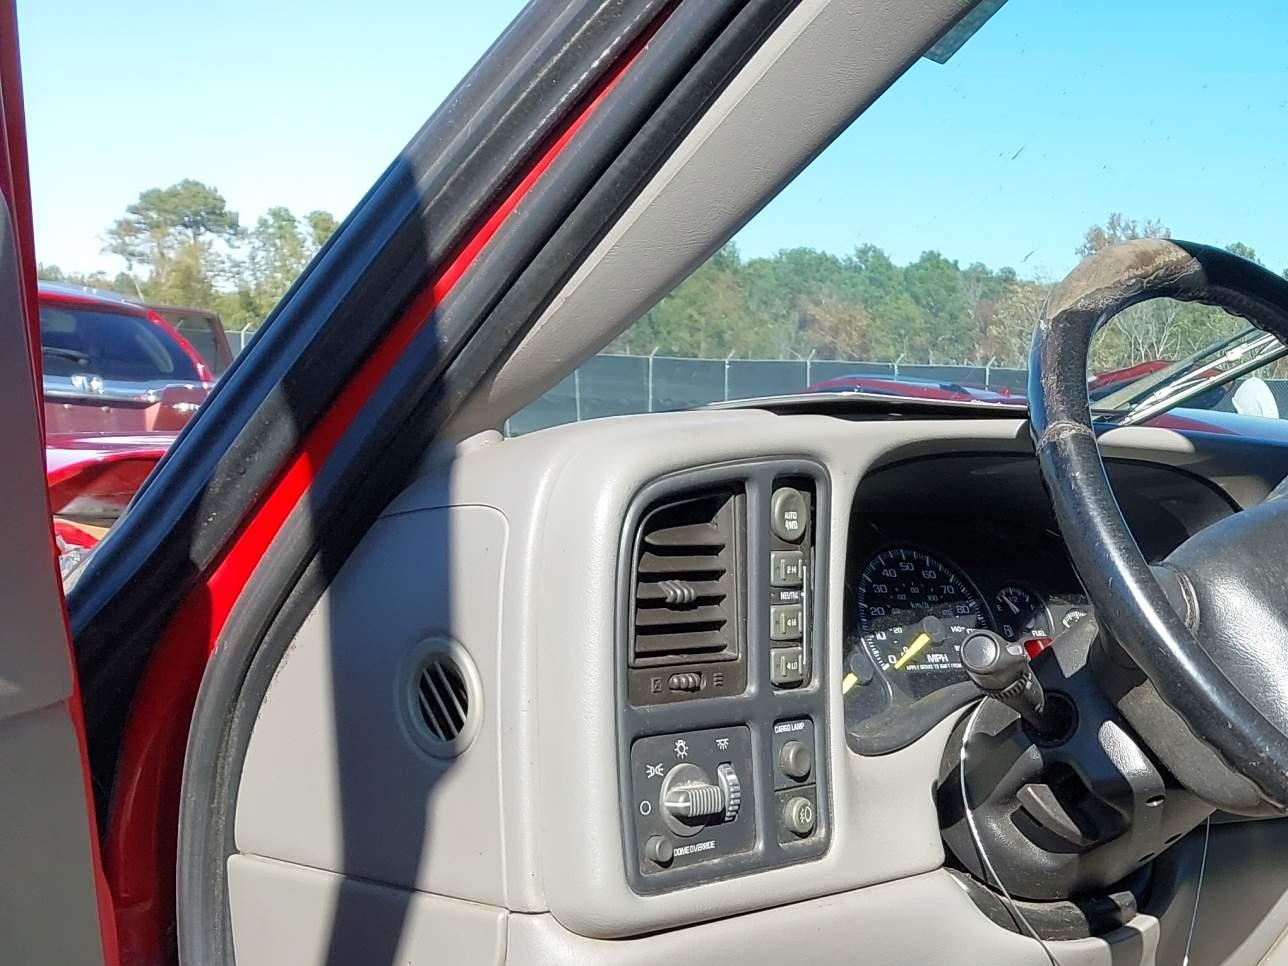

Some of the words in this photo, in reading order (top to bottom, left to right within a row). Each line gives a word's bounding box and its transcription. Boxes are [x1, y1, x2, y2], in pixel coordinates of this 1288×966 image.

[784, 511, 798, 520] AUTO
[899, 562, 914, 571] 50
[881, 568, 897, 578] 40
[922, 570, 936, 579] 60
[872, 584, 887, 593] 30
[940, 585, 954, 594] 70
[870, 606, 885, 616] 20
[956, 605, 969, 614] 80
[876, 631, 886, 640] 10
[888, 654, 897, 664] 0
[926, 654, 949, 663] MPH
[774, 723, 791, 734] CARGO
[791, 722, 805, 731] LAMP
[673, 845, 690, 857] DOME
[690, 840, 716, 852] OVERRIDE
